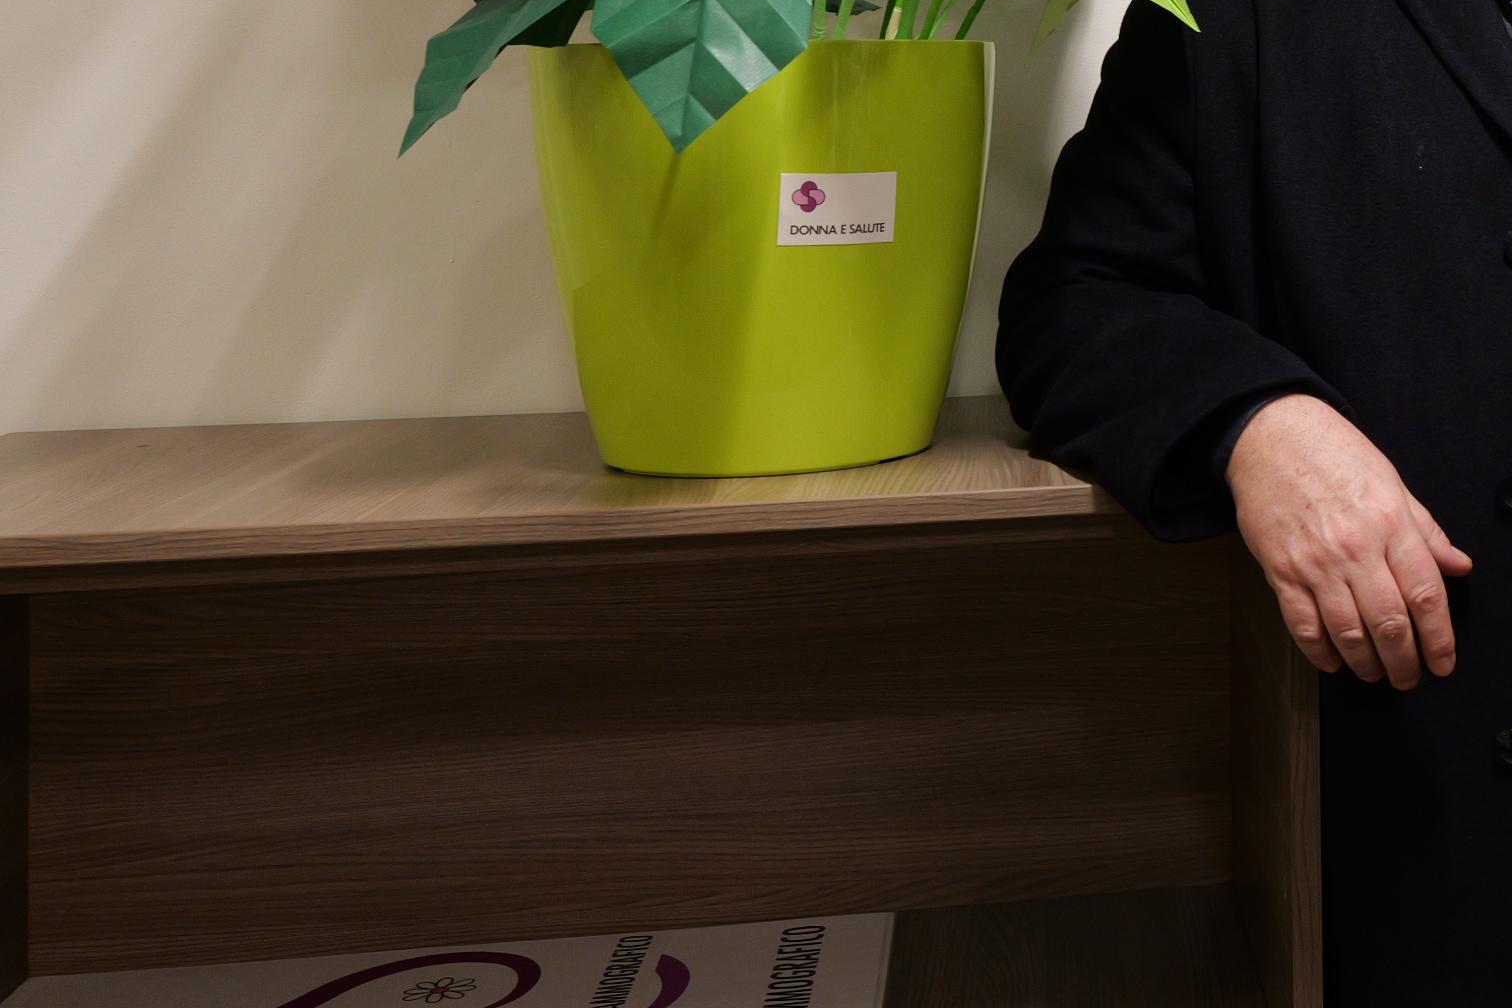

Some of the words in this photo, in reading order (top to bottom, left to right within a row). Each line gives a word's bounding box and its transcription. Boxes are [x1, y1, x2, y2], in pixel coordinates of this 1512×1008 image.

[790, 225, 837, 235] DONNA
[841, 225, 846, 234] E
[849, 223, 885, 233] SALUTE
